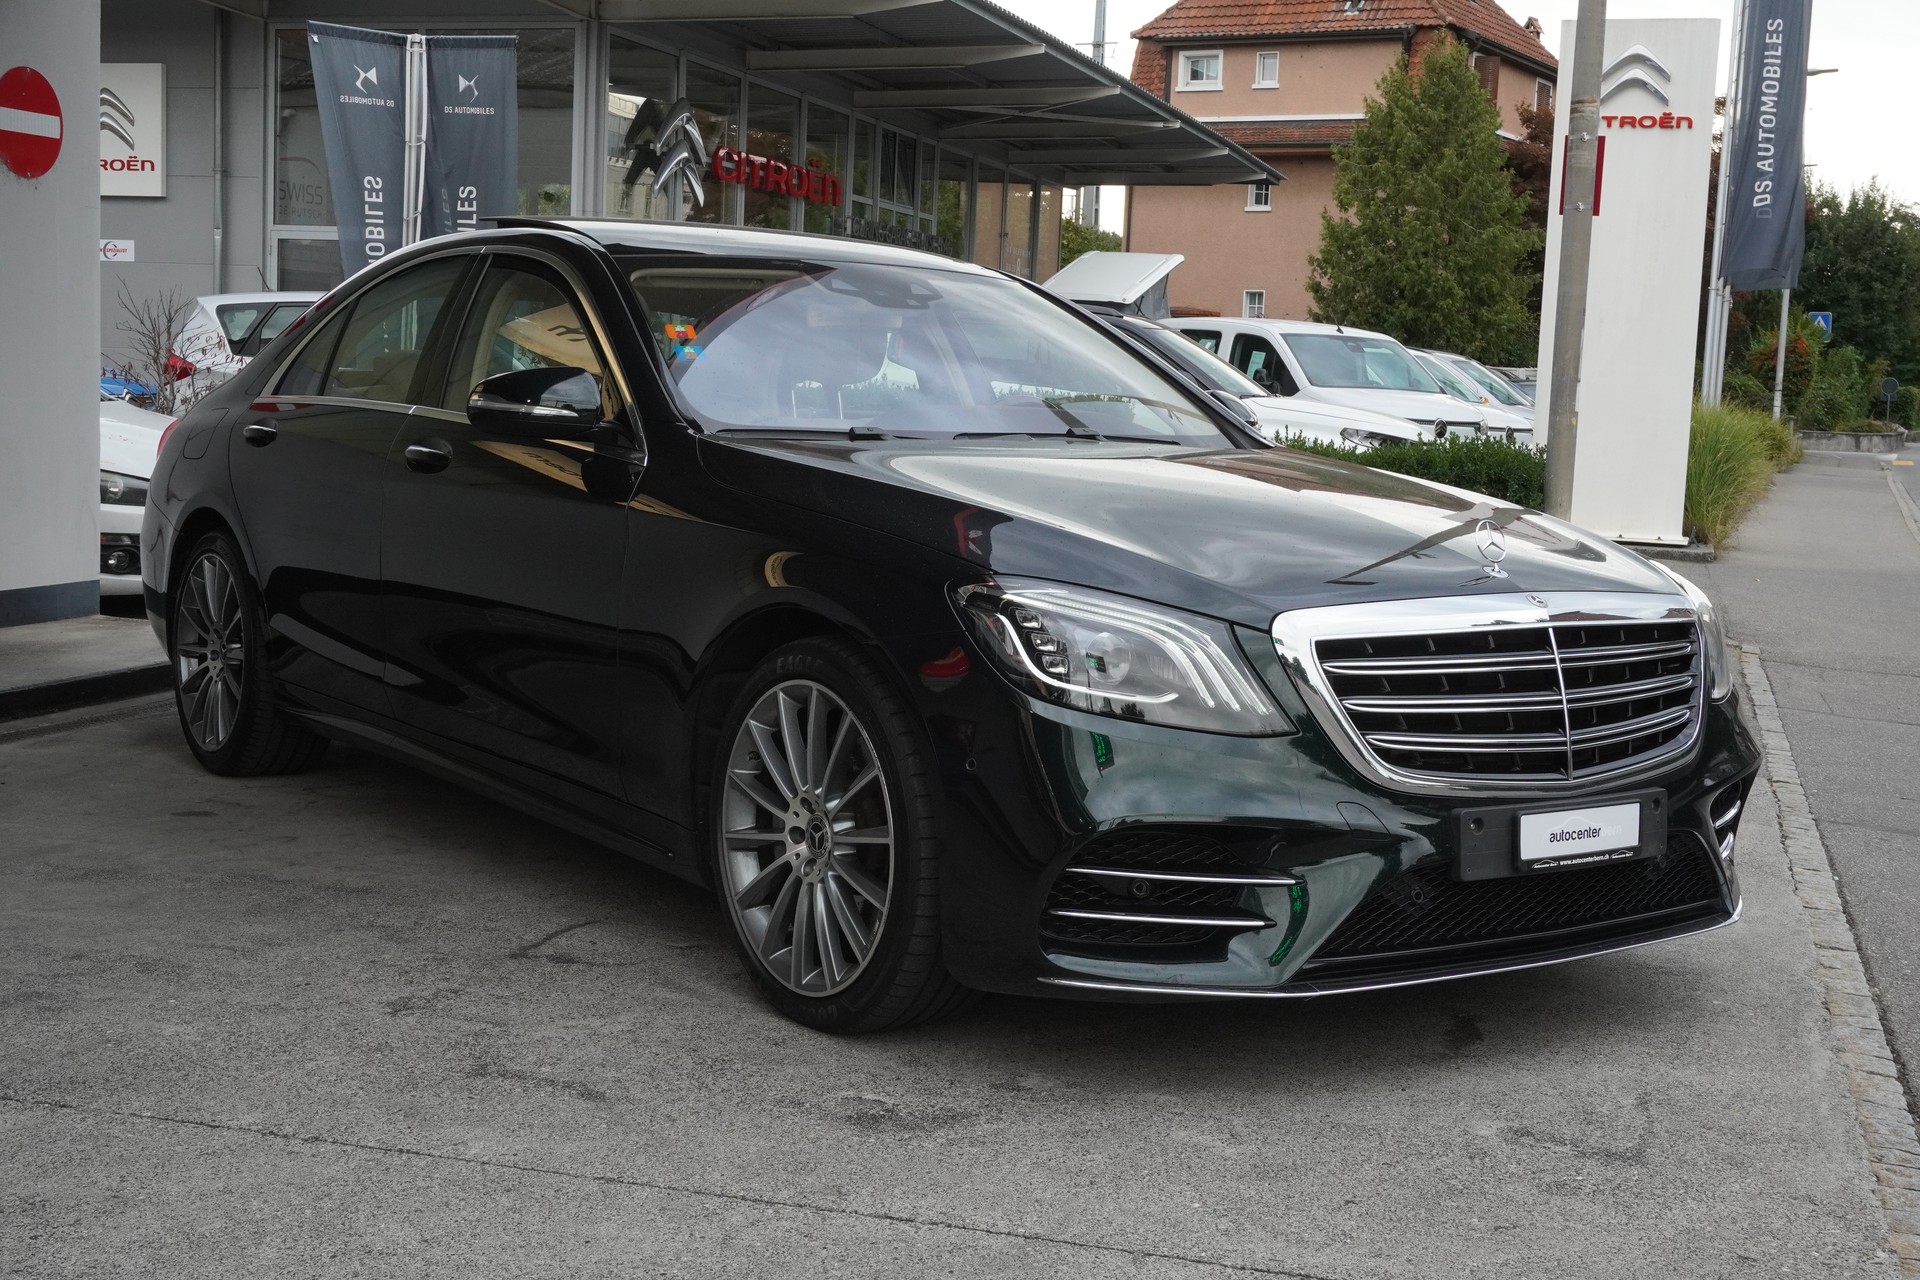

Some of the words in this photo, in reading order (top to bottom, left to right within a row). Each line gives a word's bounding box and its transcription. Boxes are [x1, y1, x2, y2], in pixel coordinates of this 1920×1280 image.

[1756, 18, 1784, 172] AUTOMOBILES
[444, 105, 453, 113] DS
[454, 106, 495, 115] AUTOMOBILES
[1601, 111, 1693, 129] TROËN
[100, 155, 155, 172] ROËN
[711, 145, 842, 207] CITROËN
[1752, 180, 1773, 208] DS
[1560, 853, 1609, 866] www.autocenterbern.ch
